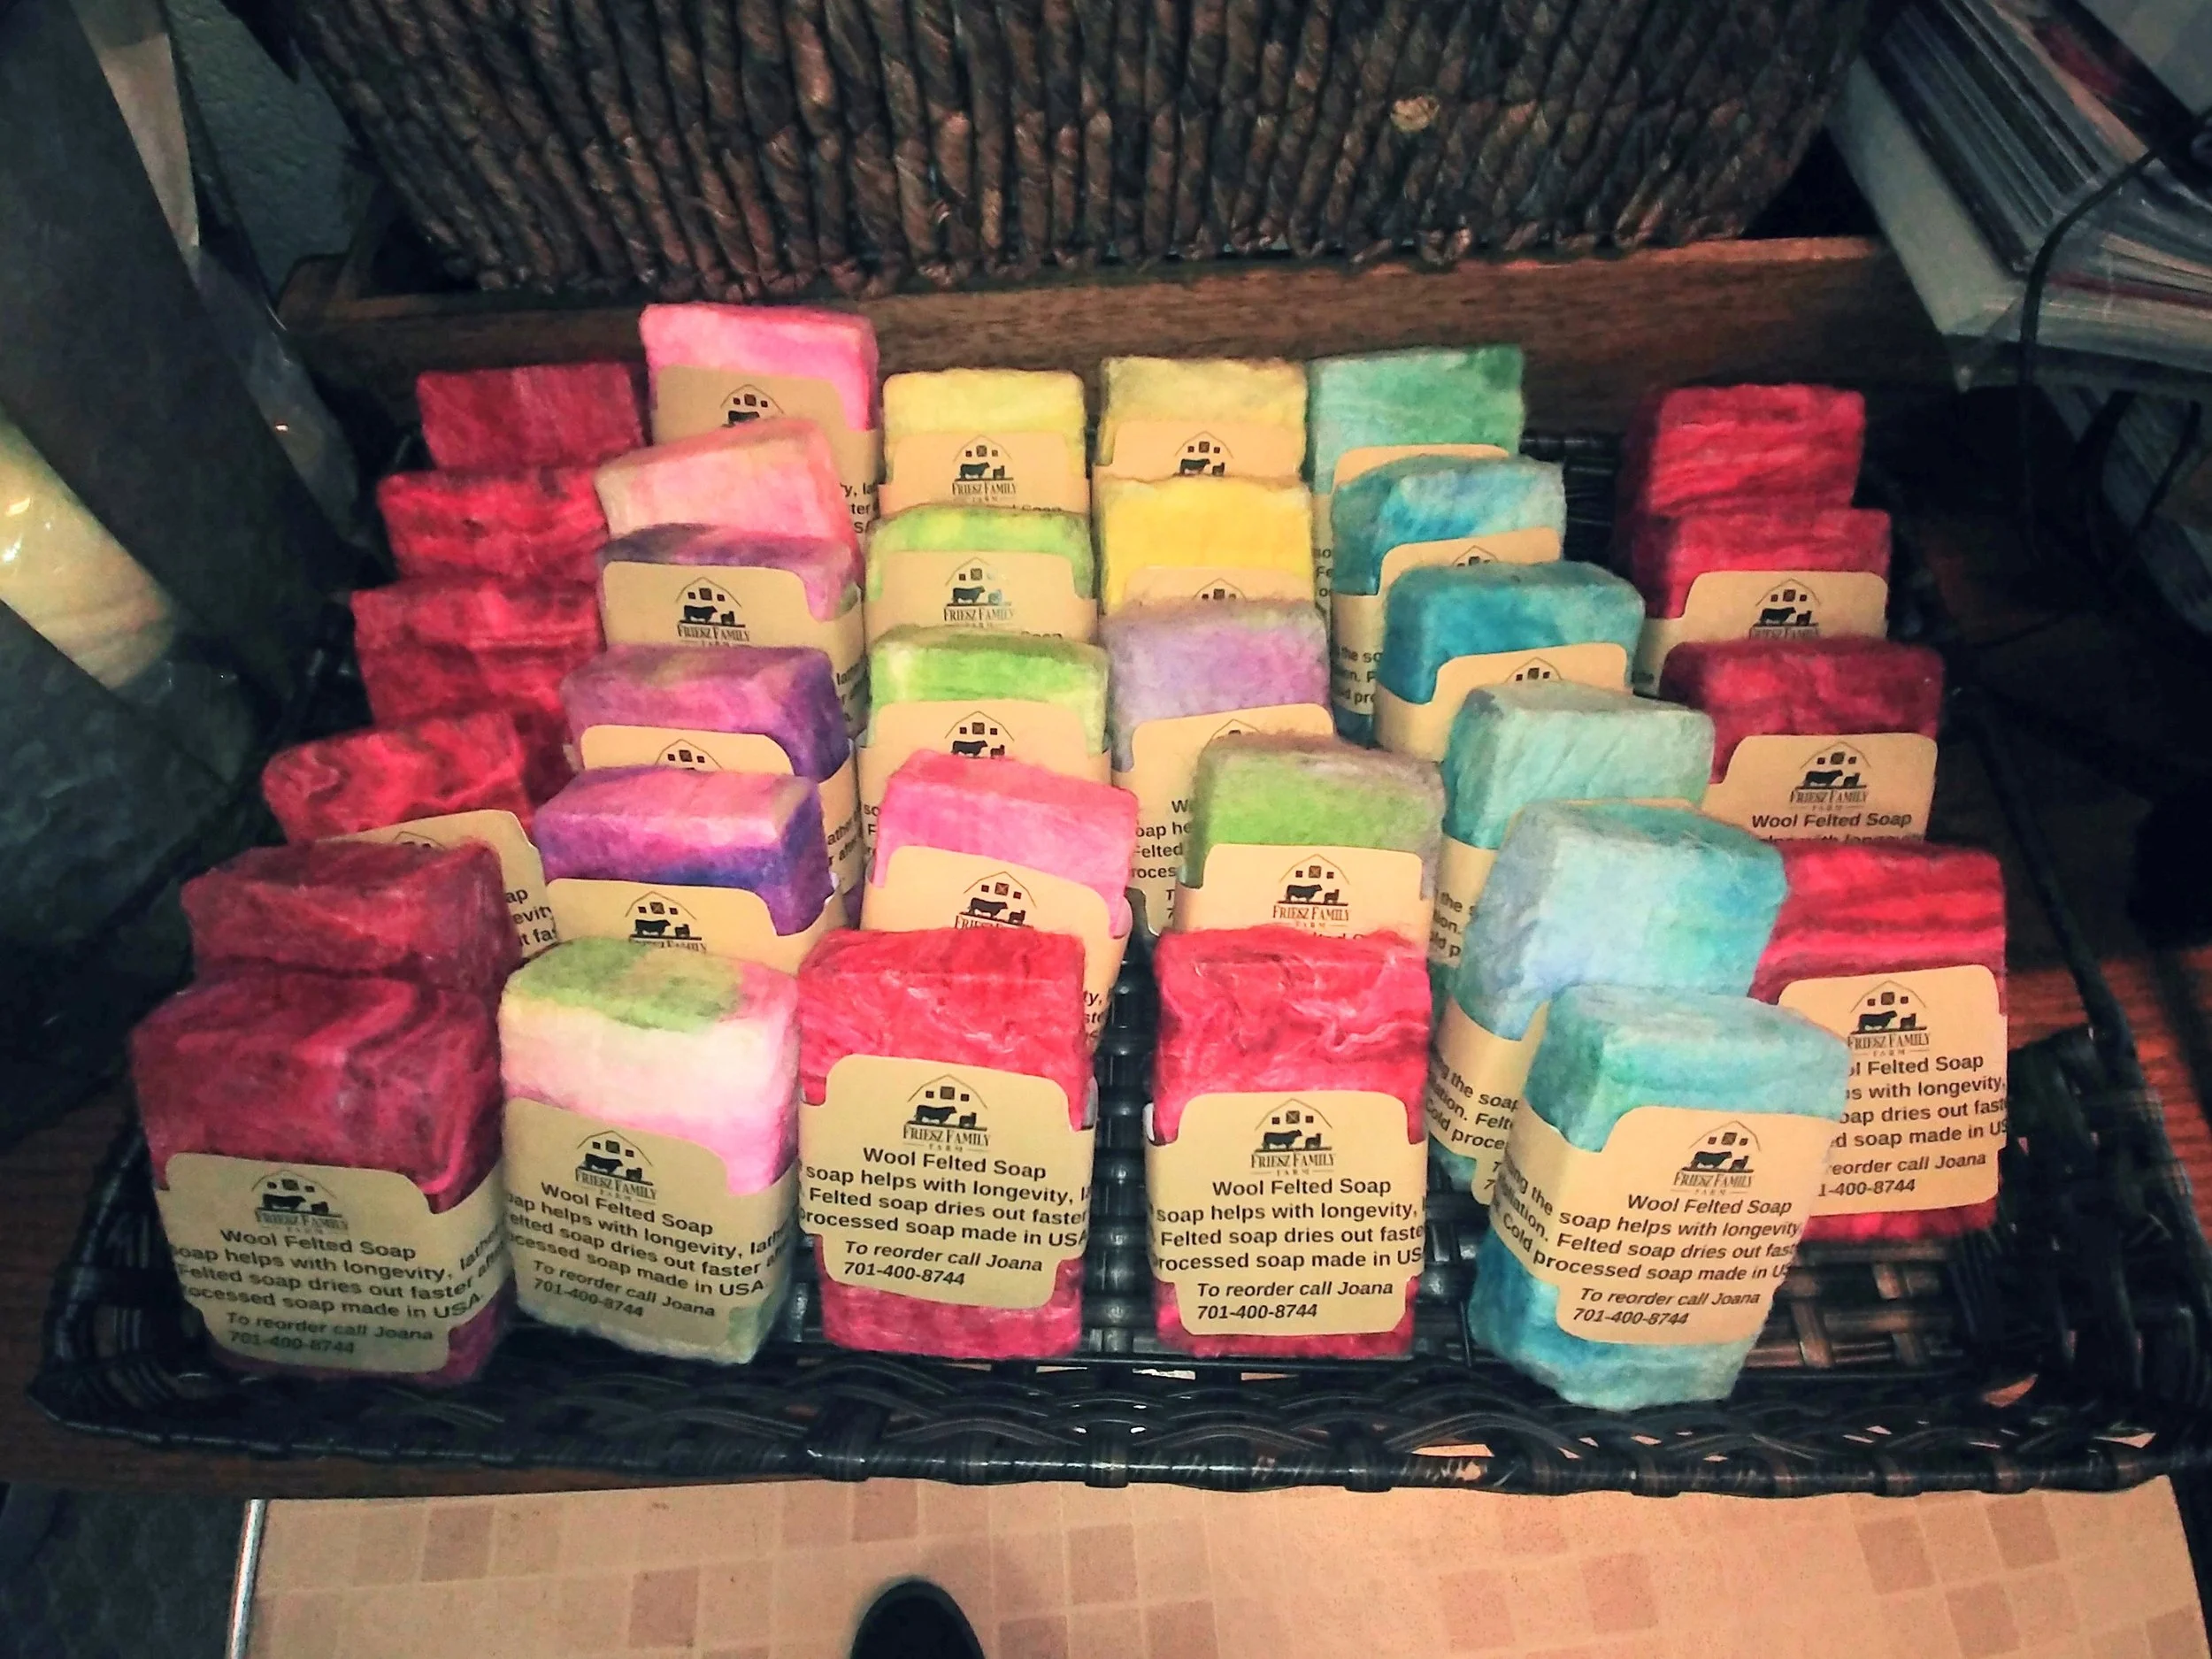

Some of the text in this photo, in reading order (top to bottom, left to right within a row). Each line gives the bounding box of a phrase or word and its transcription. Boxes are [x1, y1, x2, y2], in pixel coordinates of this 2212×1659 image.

[952, 481, 1017, 495] FRIESZ FAMILY
[944, 607, 1015, 621] FRIESZ FAMILY
[677, 624, 750, 642] FRIESZ FAMILY
[1752, 812, 1912, 828] Wool Felted Soap
[1135, 825, 1167, 840] oap
[1272, 904, 1350, 921] FRIESZ FAMILY
[1888, 1033, 1930, 1048] FAMILY
[1868, 1057, 1929, 1076] Felted
[1936, 1056, 1984, 1071] Soap
[1448, 1071, 1474, 1099] the
[1869, 1082, 1911, 1099] with
[1475, 1111, 1513, 1131] Felt
[1839, 1102, 1969, 1126] oap dries out
[902, 1125, 992, 1148] FRIESZ FAMILY
[1855, 1132, 1902, 1148] soap
[1909, 1125, 1962, 1144] made
[1968, 1125, 1985, 1139] in
[863, 1147, 1048, 1180] Wool Felted Soap
[1250, 1152, 1337, 1169] FRIESZ FAMILY
[1829, 1153, 1986, 1176] eorder call Joana
[616, 1181, 658, 1201] FAMILY
[806, 1165, 854, 1186] soap
[861, 1170, 918, 1192] helps
[924, 1178, 966, 1194] with
[973, 1180, 1073, 1207] longevity,
[1211, 1177, 1392, 1197] Wool Felted Soap
[1817, 1179, 1916, 1197] 1-400-8744
[541, 1181, 714, 1237] Wool Felted Soap
[810, 1187, 872, 1208] Felted
[879, 1197, 928, 1216] soap
[934, 1200, 986, 1218] dries
[992, 1206, 1025, 1222] out
[1156, 1201, 1417, 1225] soap helps with longevity,
[1531, 1185, 1554, 1217] the
[1559, 1211, 1611, 1233] soap
[1617, 1212, 1672, 1236] helps
[1677, 1218, 1717, 1237] with
[1627, 1193, 1793, 1217] Wool Felted Soap
[541, 1202, 593, 1227] helps
[598, 1217, 640, 1238] with
[643, 1228, 743, 1260] longevity,
[905, 1220, 956, 1240] soap
[962, 1226, 1018, 1244] made
[1023, 1230, 1042, 1247] in
[1161, 1223, 1425, 1248] Felted soap dries out faste
[219, 1227, 278, 1247] Wool
[284, 1234, 353, 1254] Felted
[359, 1241, 417, 1261] Soap
[510, 1212, 761, 1278] elted soap dries out faster
[845, 1240, 1044, 1272] To reorder call Joana
[1502, 1213, 1768, 1283] Cold processed soap made in
[1557, 1232, 1763, 1261] Felted soap dries out
[177, 1245, 454, 1283] oap helps with longevity,
[1256, 1251, 1305, 1271] soap
[1311, 1250, 1366, 1267] made
[1372, 1250, 1391, 1266] in
[1396, 1247, 1423, 1265] US
[586, 1252, 632, 1276] soap
[637, 1267, 689, 1291] made
[695, 1279, 713, 1294] in
[844, 1260, 966, 1286] 701-400-8744
[250, 1271, 303, 1291] soap
[308, 1278, 362, 1295] dries
[369, 1283, 403, 1299] out
[411, 1279, 472, 1302] faster
[534, 1259, 716, 1317] To reorder call Joana
[534, 1278, 646, 1318] 701-400-8744
[1197, 1280, 1394, 1297] To reorder call Joana
[1579, 1286, 1761, 1307] To reorder call Joana
[185, 1282, 426, 1318] ocessed soap made in
[1197, 1303, 1318, 1320] 701-400-8744
[226, 1310, 434, 1341] To reorder call Joana
[1572, 1308, 1690, 1325] 701-400-8744
[228, 1329, 355, 1355] 701-400-8744
